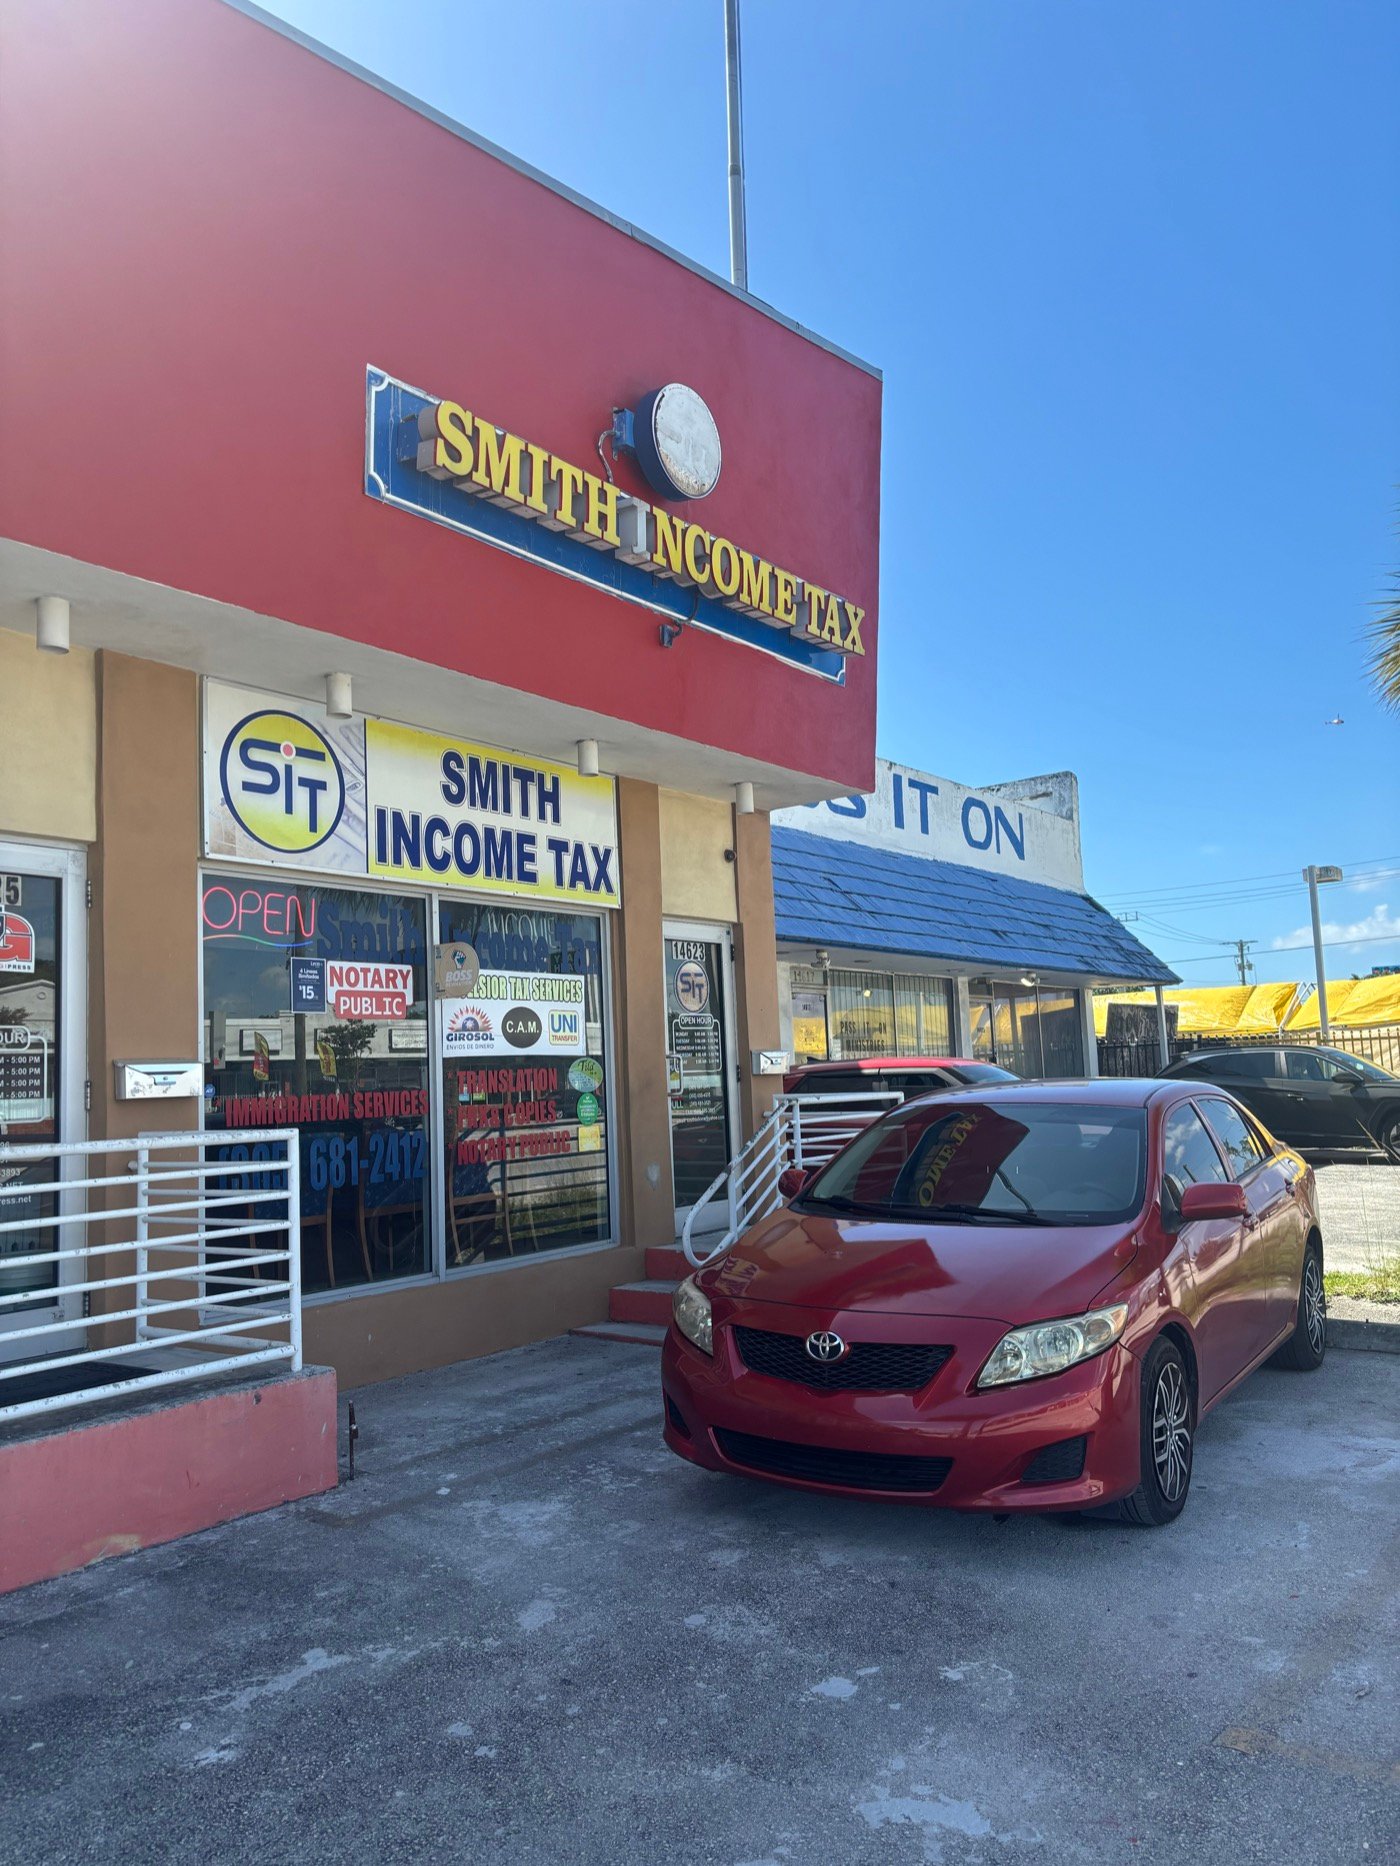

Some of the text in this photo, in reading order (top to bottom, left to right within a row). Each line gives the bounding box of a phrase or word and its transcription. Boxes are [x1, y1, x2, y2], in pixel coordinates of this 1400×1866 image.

[434, 400, 866, 657] SMITH INCOME TAX
[439, 748, 561, 826] SMITH
[892, 774, 1025, 861] IT ON
[374, 805, 616, 895] INCOME TAX
[203, 886, 315, 937] OPEN
[317, 900, 424, 963] Smith
[673, 942, 705, 960] 14623
[329, 965, 411, 990] NOTARY
[446, 969, 473, 983] BOSS
[508, 975, 531, 1001] TAX
[532, 976, 583, 1003] SERVICES
[339, 997, 403, 1016] PUBLIC
[506, 1020, 540, 1033] C.A.M.
[550, 1013, 577, 1033] UNI
[681, 1016, 712, 1025] OPEN HOUR
[840, 1021, 887, 1034] PASS IT ON
[446, 1032, 494, 1042] GIROSOL
[552, 1034, 577, 1042] TRANSFER
[846, 1039, 885, 1052] MINISTRIES
[11, 1055, 27, 1064] 5:00
[28, 1055, 41, 1064] PM
[11, 1067, 27, 1076] 5:00
[28, 1067, 41, 1076] PM
[457, 1067, 558, 1094] TRANSLATION
[11, 1079, 27, 1087] 5:00
[28, 1079, 41, 1087] PM
[11, 1090, 27, 1099] 5:00
[28, 1090, 41, 1099] PM
[225, 1089, 429, 1128] IMMIGRATION SERVICES
[503, 1100, 557, 1127] COPIES
[457, 1135, 517, 1165] NOTARY
[519, 1130, 571, 1157] PUBLIC
[309, 1131, 426, 1191] 681-2412
